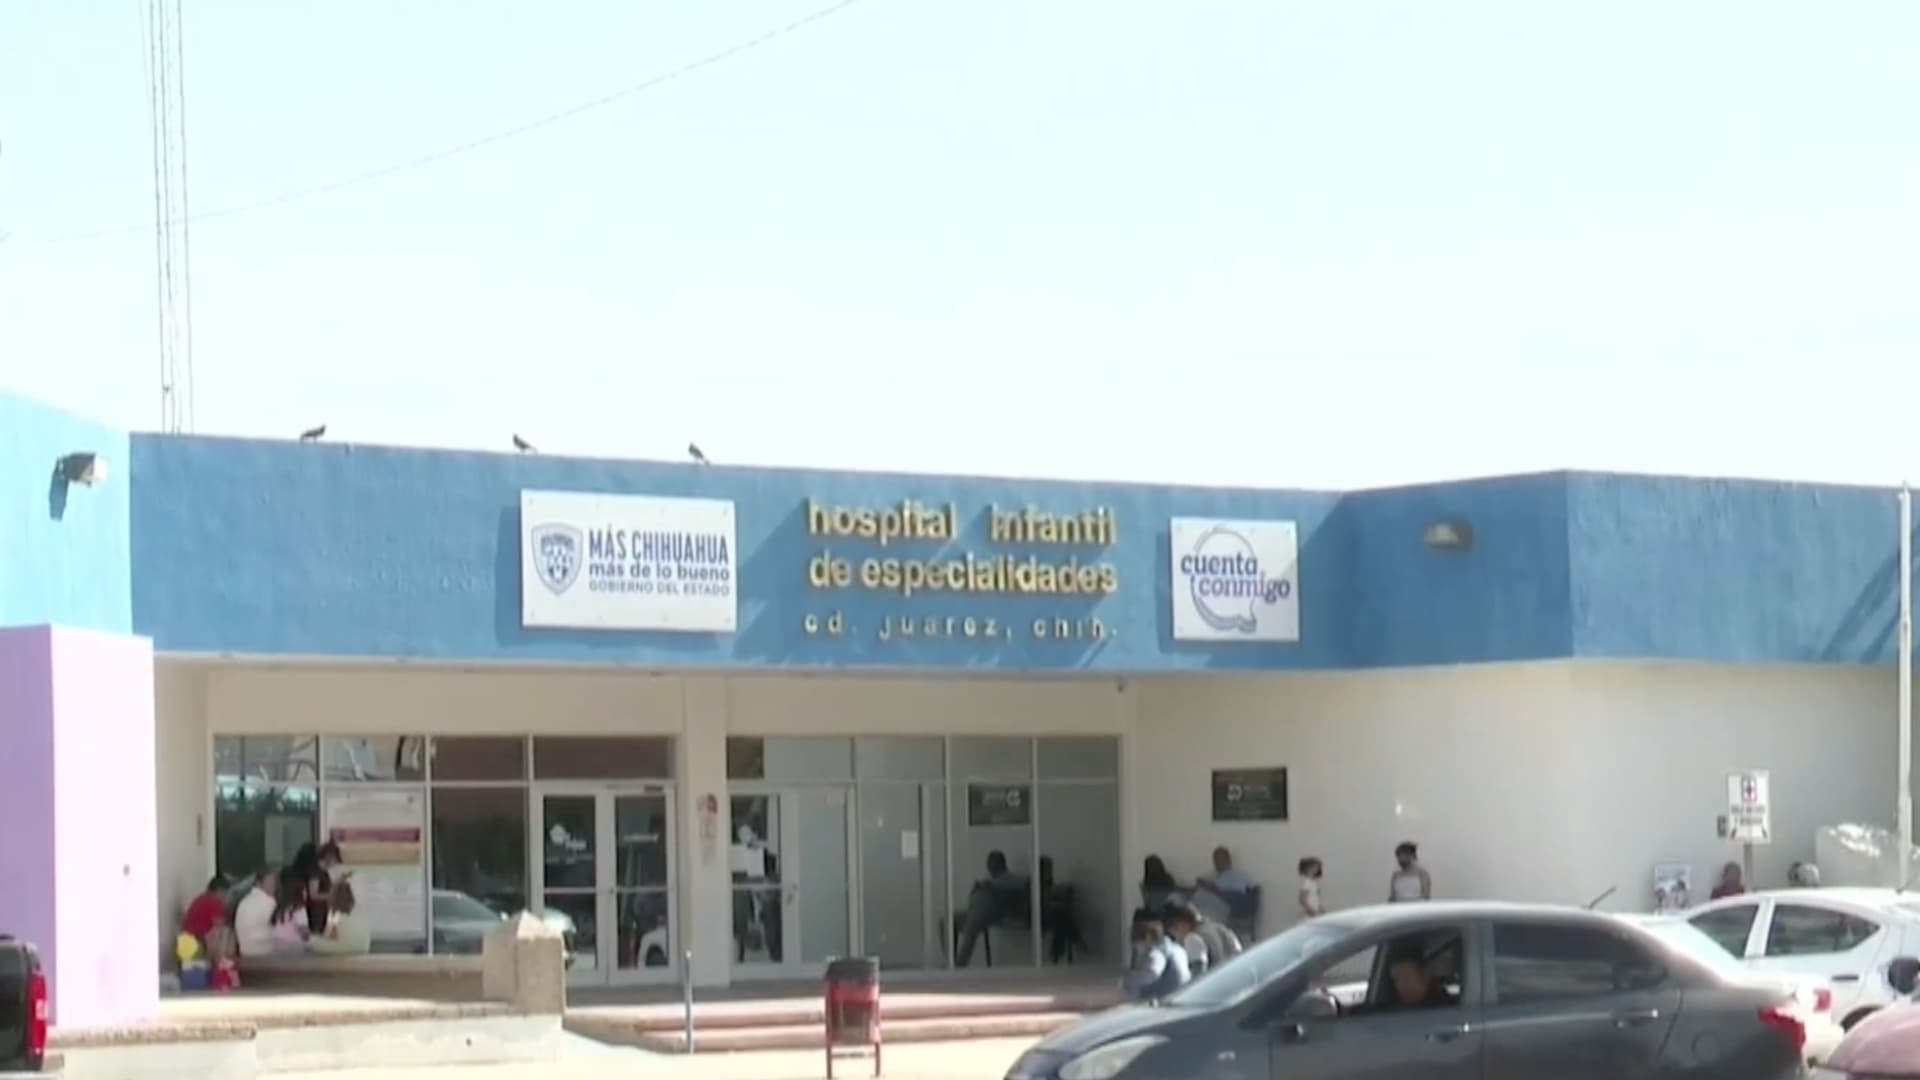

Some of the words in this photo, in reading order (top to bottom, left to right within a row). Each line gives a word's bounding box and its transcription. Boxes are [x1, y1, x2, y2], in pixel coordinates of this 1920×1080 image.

[808, 496, 957, 546] hospital
[991, 502, 1117, 544] infantil
[588, 523, 627, 560] MÁS
[631, 529, 730, 565] CHIHUAHUA
[629, 561, 651, 578] de
[656, 562, 672, 579] lo
[677, 563, 731, 581] bueno
[809, 549, 851, 588] de
[861, 552, 1119, 598] especialidades
[1180, 551, 1258, 576] cuenta
[588, 579, 654, 596] GOBIERNO
[657, 581, 678, 596] DEL
[683, 582, 730, 597] ESTADO
[1198, 570, 1291, 605] conmigo
